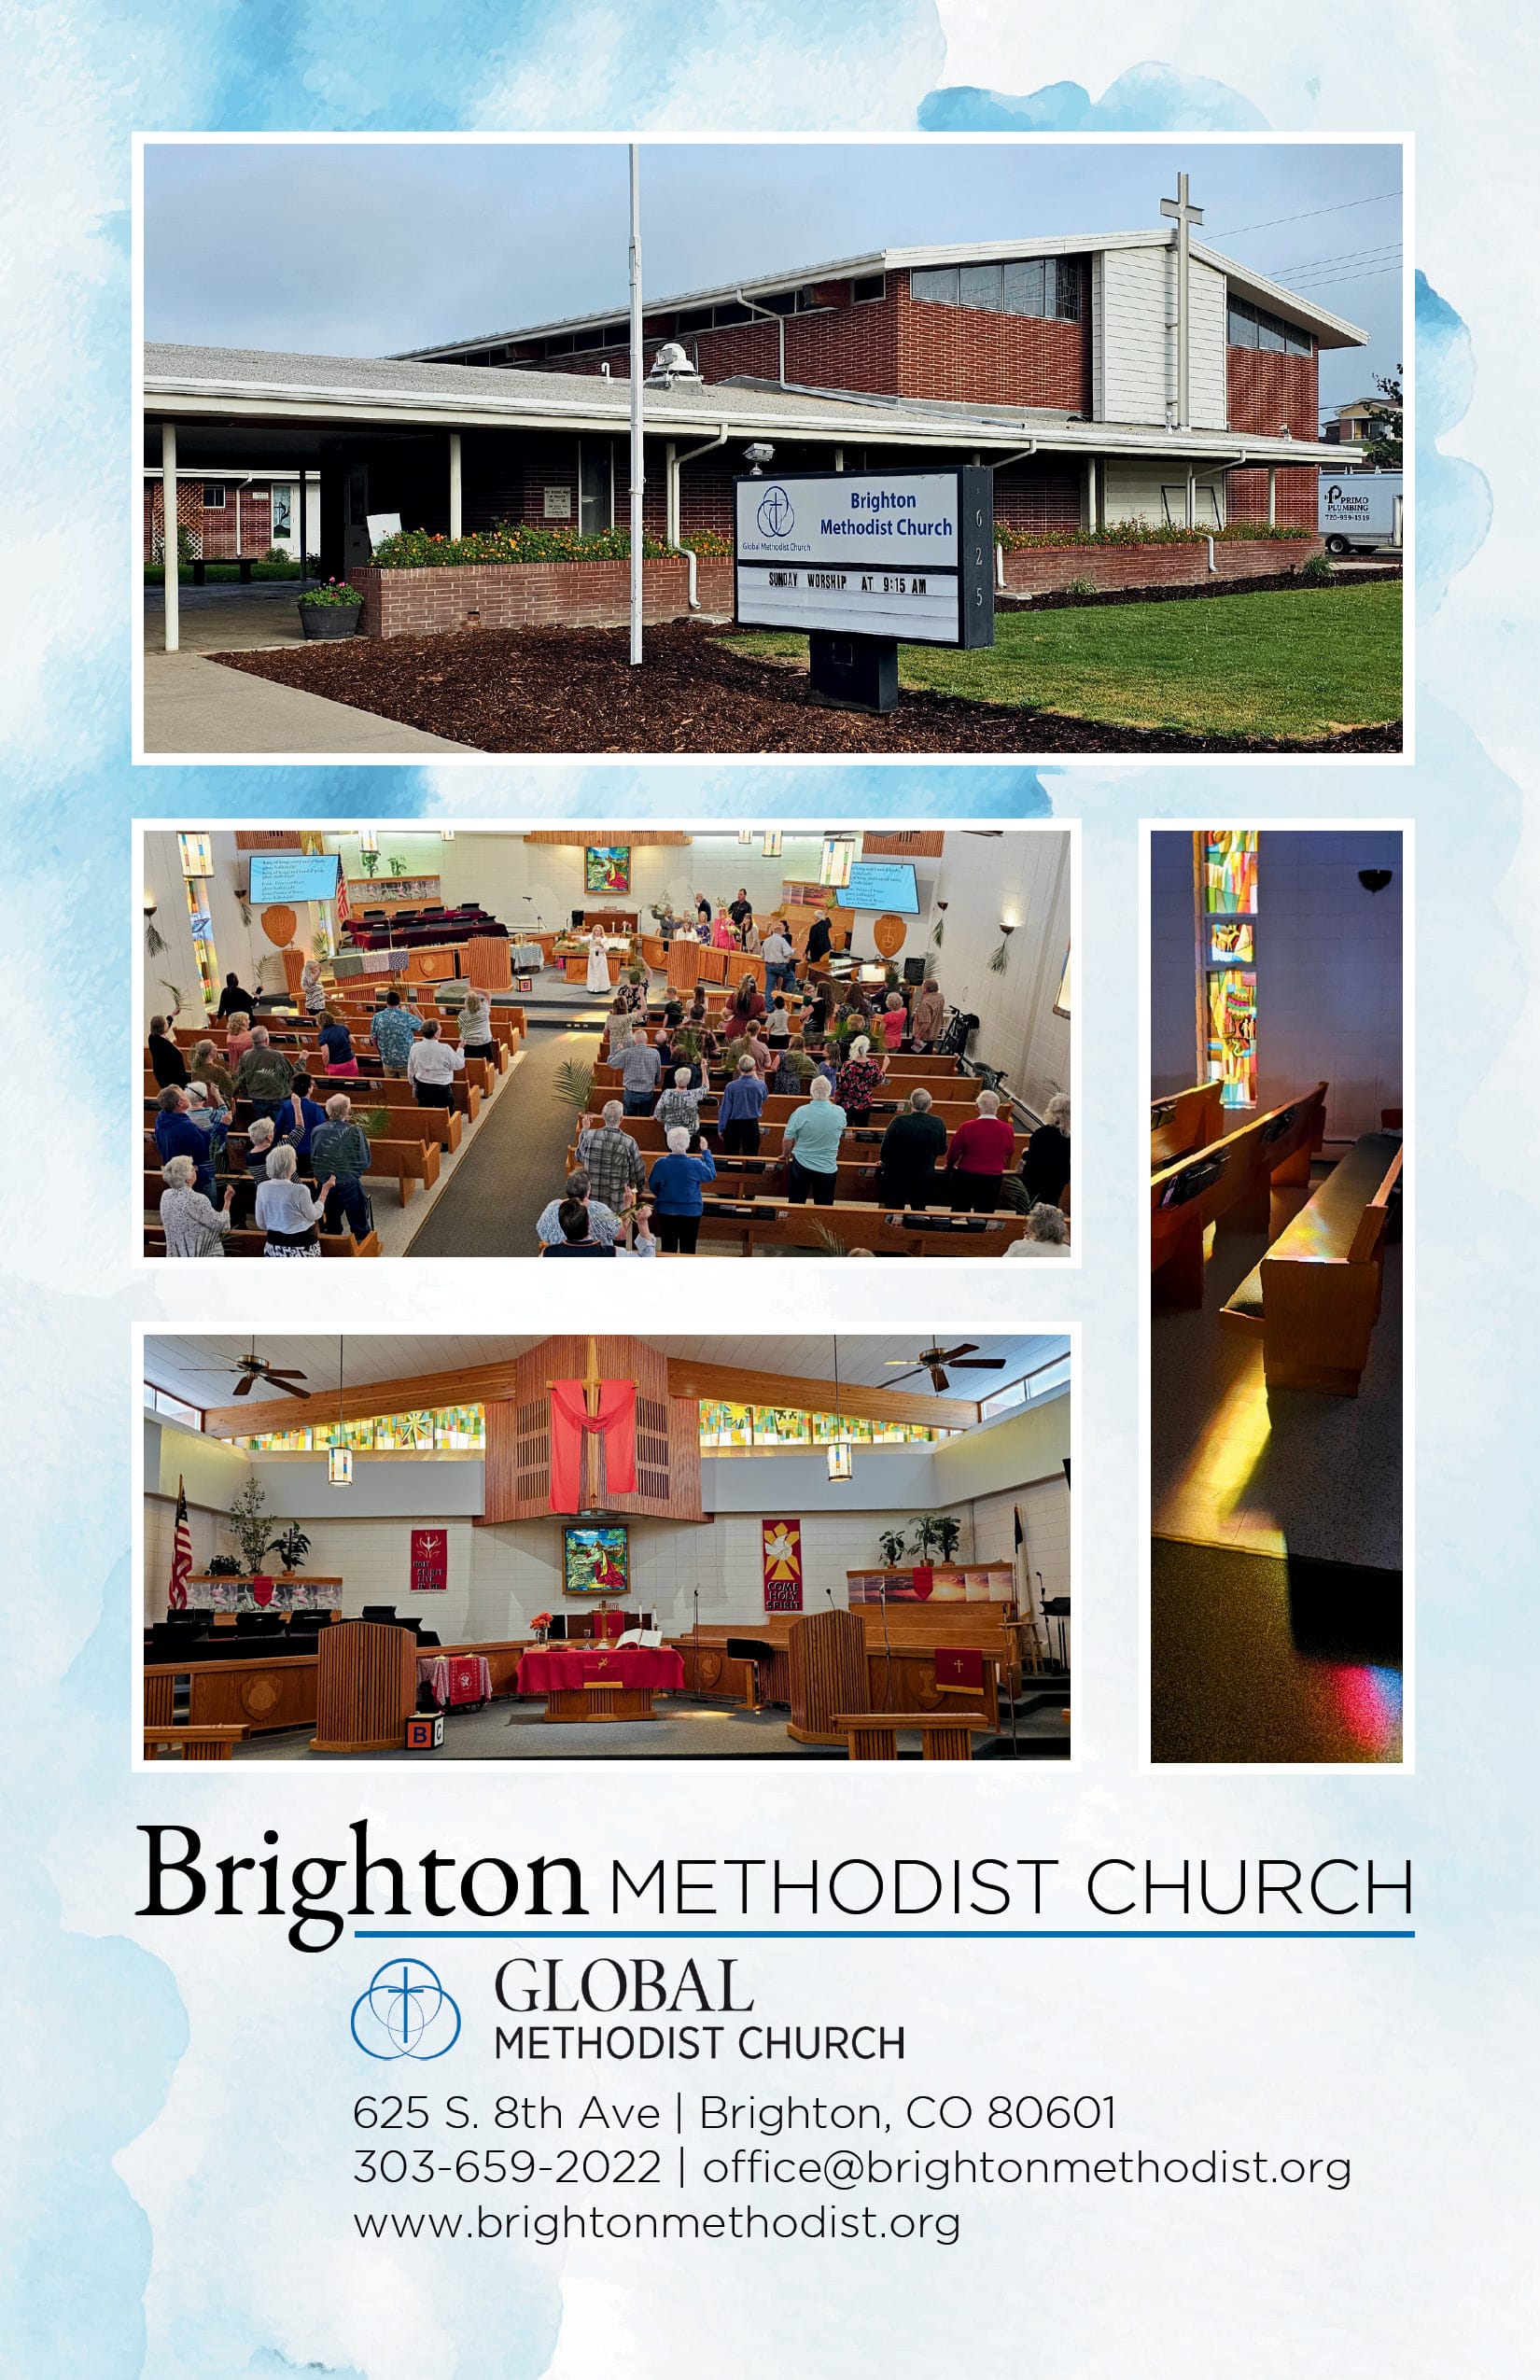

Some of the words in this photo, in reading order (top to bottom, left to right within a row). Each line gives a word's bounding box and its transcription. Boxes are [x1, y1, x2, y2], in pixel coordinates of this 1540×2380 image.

[850, 491, 917, 512] Brighton
[820, 518, 893, 536] Methodist
[896, 518, 953, 536] Church
[742, 541, 760, 551] Global
[761, 542, 790, 552] Methodist
[790, 542, 811, 552] Church
[769, 571, 798, 587] SUNDAY
[807, 573, 847, 590] WORSHIP
[861, 576, 874, 591] AT
[883, 577, 906, 593] 9:15
[911, 579, 927, 595] AM
[767, 1581, 799, 1591] COME
[769, 1590, 798, 1601] HOLY
[765, 1601, 801, 1610] SPIRIT
[413, 1726, 427, 1743] B
[436, 1723, 441, 1741] C
